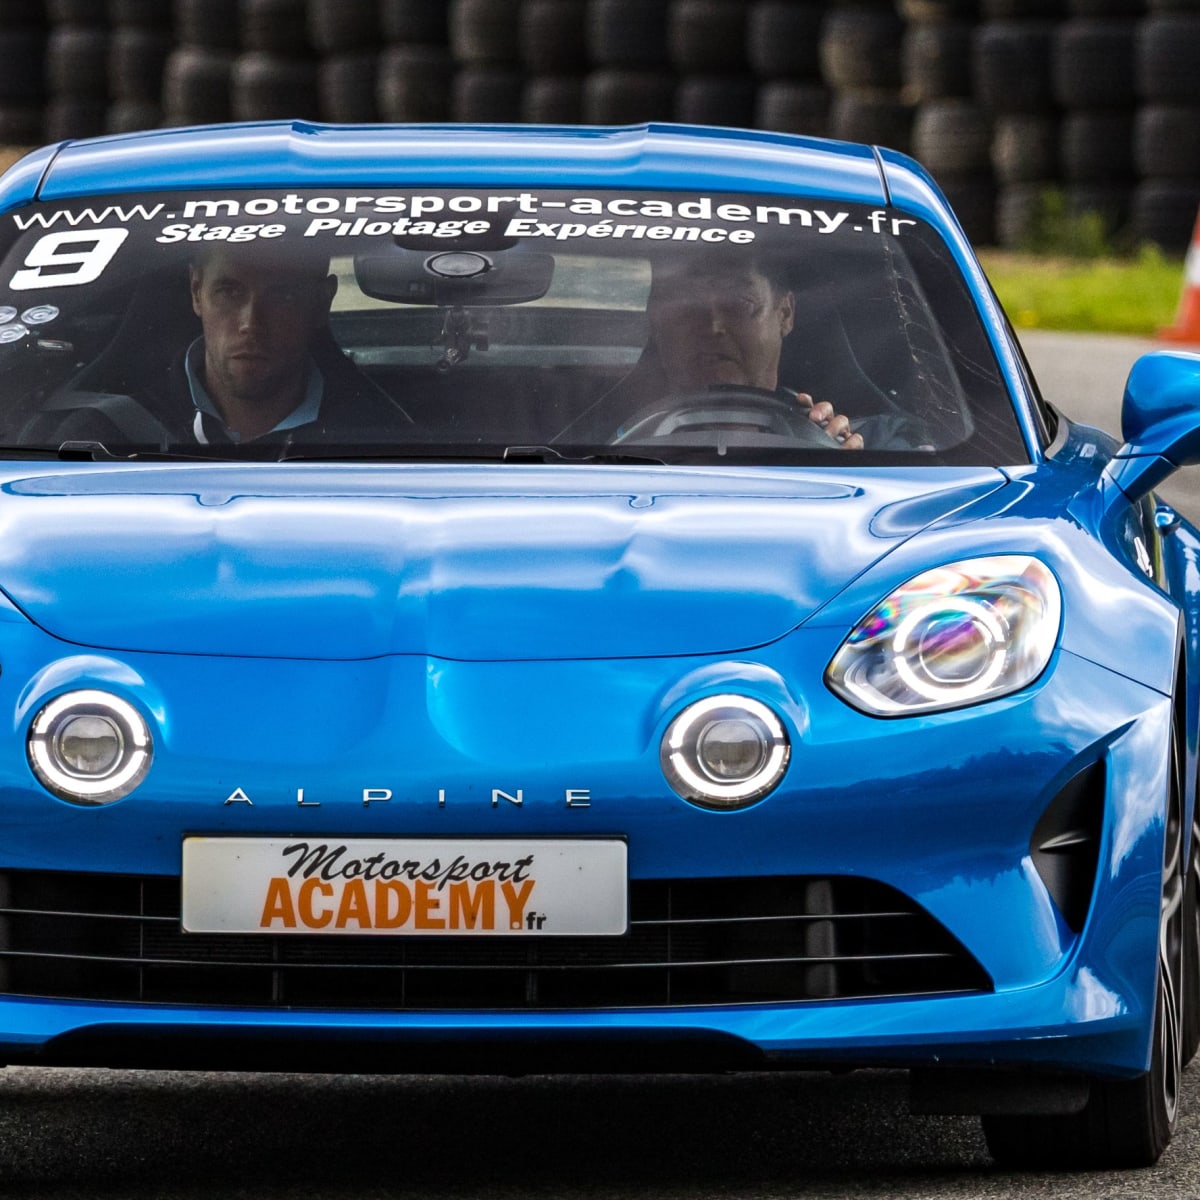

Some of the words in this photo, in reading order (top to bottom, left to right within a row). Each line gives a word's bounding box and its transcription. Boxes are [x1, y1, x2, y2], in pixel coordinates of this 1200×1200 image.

[13, 194, 917, 235] www.motorsport-academy.fr
[156, 222, 286, 243] Stage
[304, 217, 491, 237] Pilotage
[504, 218, 755, 243] Expérience
[9, 228, 128, 290] 9
[224, 787, 591, 807] ALPINE
[282, 843, 535, 892] Motorsport
